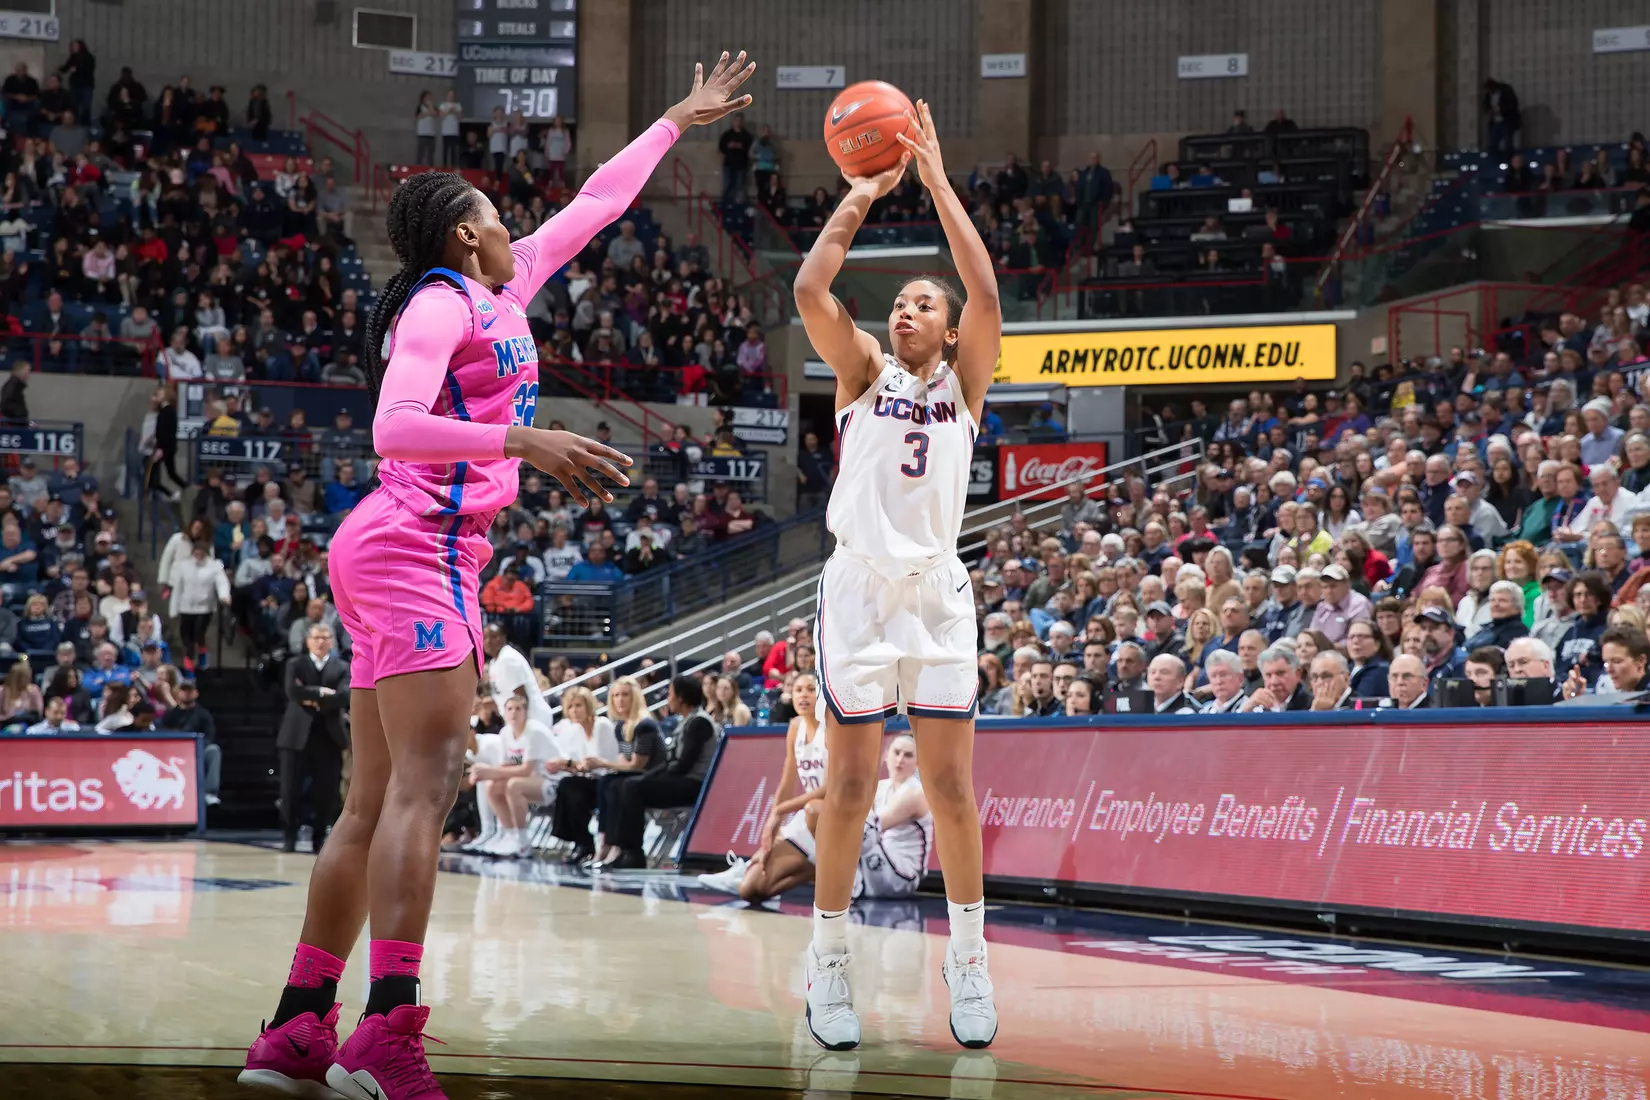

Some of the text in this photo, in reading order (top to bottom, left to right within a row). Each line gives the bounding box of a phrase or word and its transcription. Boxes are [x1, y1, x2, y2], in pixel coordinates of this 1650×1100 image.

[19, 17, 57, 37] 216
[497, 22, 537, 36] STEALS
[425, 56, 457, 72] 217
[1227, 57, 1239, 73] 8
[474, 68, 558, 84] TIME OF DAY
[825, 69, 836, 84] 7
[498, 88, 556, 117] 7:30
[839, 128, 882, 155] ELITE
[755, 409, 786, 426] 217
[873, 395, 957, 425] UCONN
[0, 432, 75, 454] EC 116
[201, 440, 281, 460] SEC 117
[901, 432, 929, 478] 3
[727, 459, 760, 478] 117
[414, 620, 446, 651] M
[980, 788, 1075, 828] Insurance
[1089, 790, 1204, 843] Employee
[1208, 794, 1318, 841] Benefits
[1340, 797, 1488, 850] Financial
[1488, 801, 1647, 858] Services
